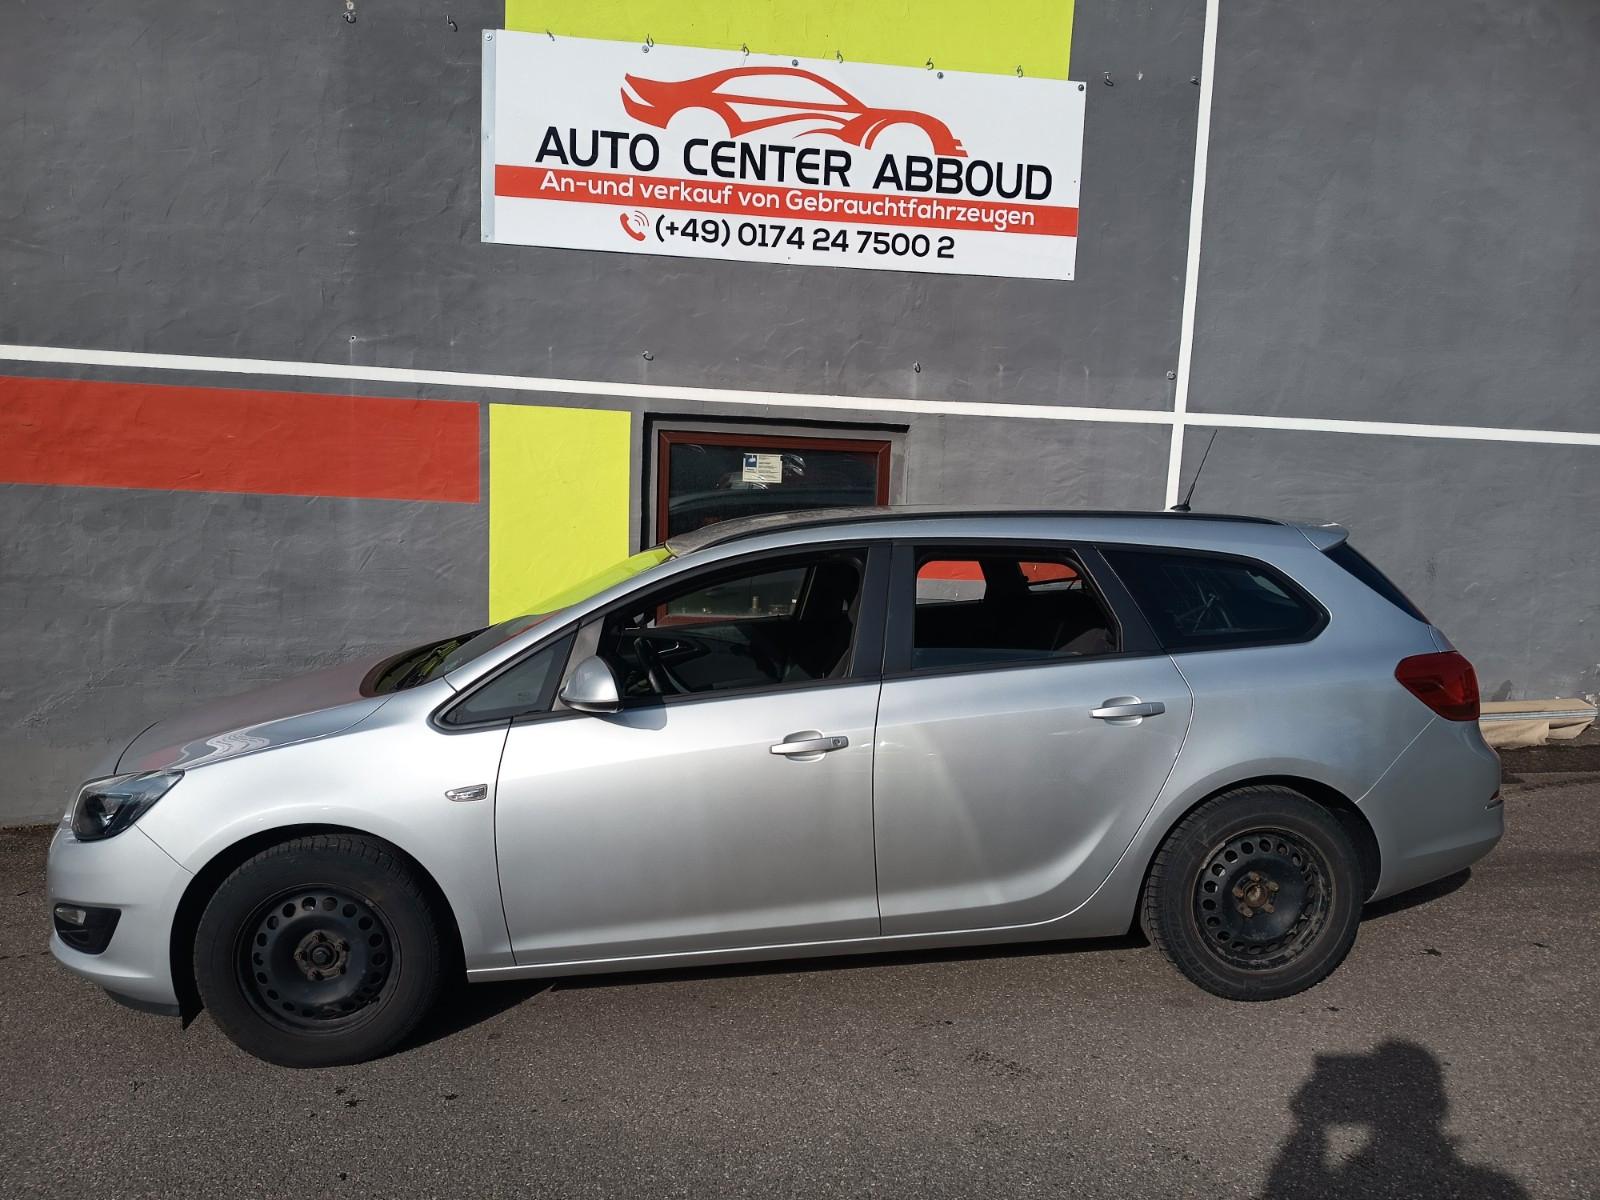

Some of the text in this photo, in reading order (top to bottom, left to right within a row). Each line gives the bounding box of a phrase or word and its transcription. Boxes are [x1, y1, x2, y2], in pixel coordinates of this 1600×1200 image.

[534, 126, 1053, 199] AUTO CENTER ABBOUD
[539, 171, 1035, 229] An-und verkauf von Gebrauchtfahrzeugen
[655, 214, 731, 248] (+49)
[737, 222, 805, 250] 0174
[812, 227, 849, 253] 24
